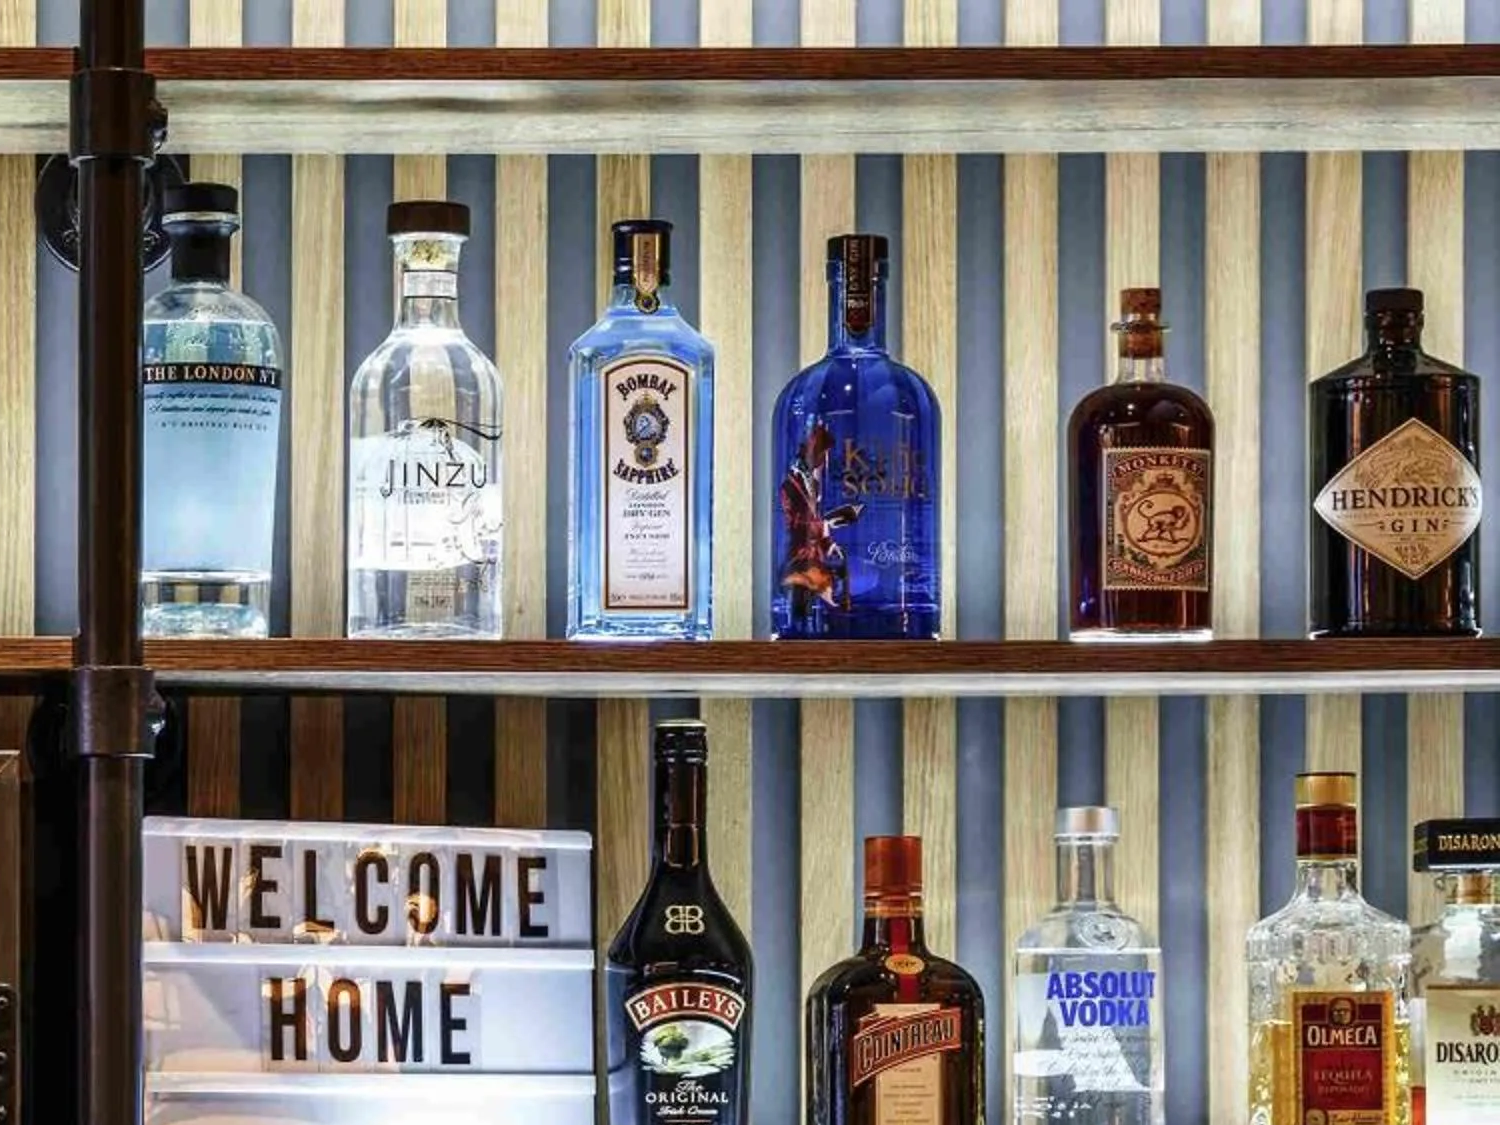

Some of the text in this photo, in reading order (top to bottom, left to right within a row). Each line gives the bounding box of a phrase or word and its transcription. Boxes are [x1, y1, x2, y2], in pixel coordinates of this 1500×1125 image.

[144, 365, 177, 382] THE
[183, 365, 256, 381] LONDON
[616, 373, 677, 400] BOMBAY
[380, 459, 487, 498] JINZU
[613, 458, 679, 484] SAPPHIRE
[1331, 486, 1479, 511] HENDRICK'S
[1391, 518, 1439, 532] GIN
[186, 844, 550, 938] WELCOME
[1047, 972, 1156, 999] ABSOLUT
[634, 988, 739, 1021] BAILEYS
[1059, 1001, 1150, 1026] VODKA
[268, 976, 472, 1065] HOME
[858, 1015, 956, 1074] COINTREAU
[1307, 1025, 1377, 1047] OLMECA
[645, 1092, 729, 1104] ORIGINAL
